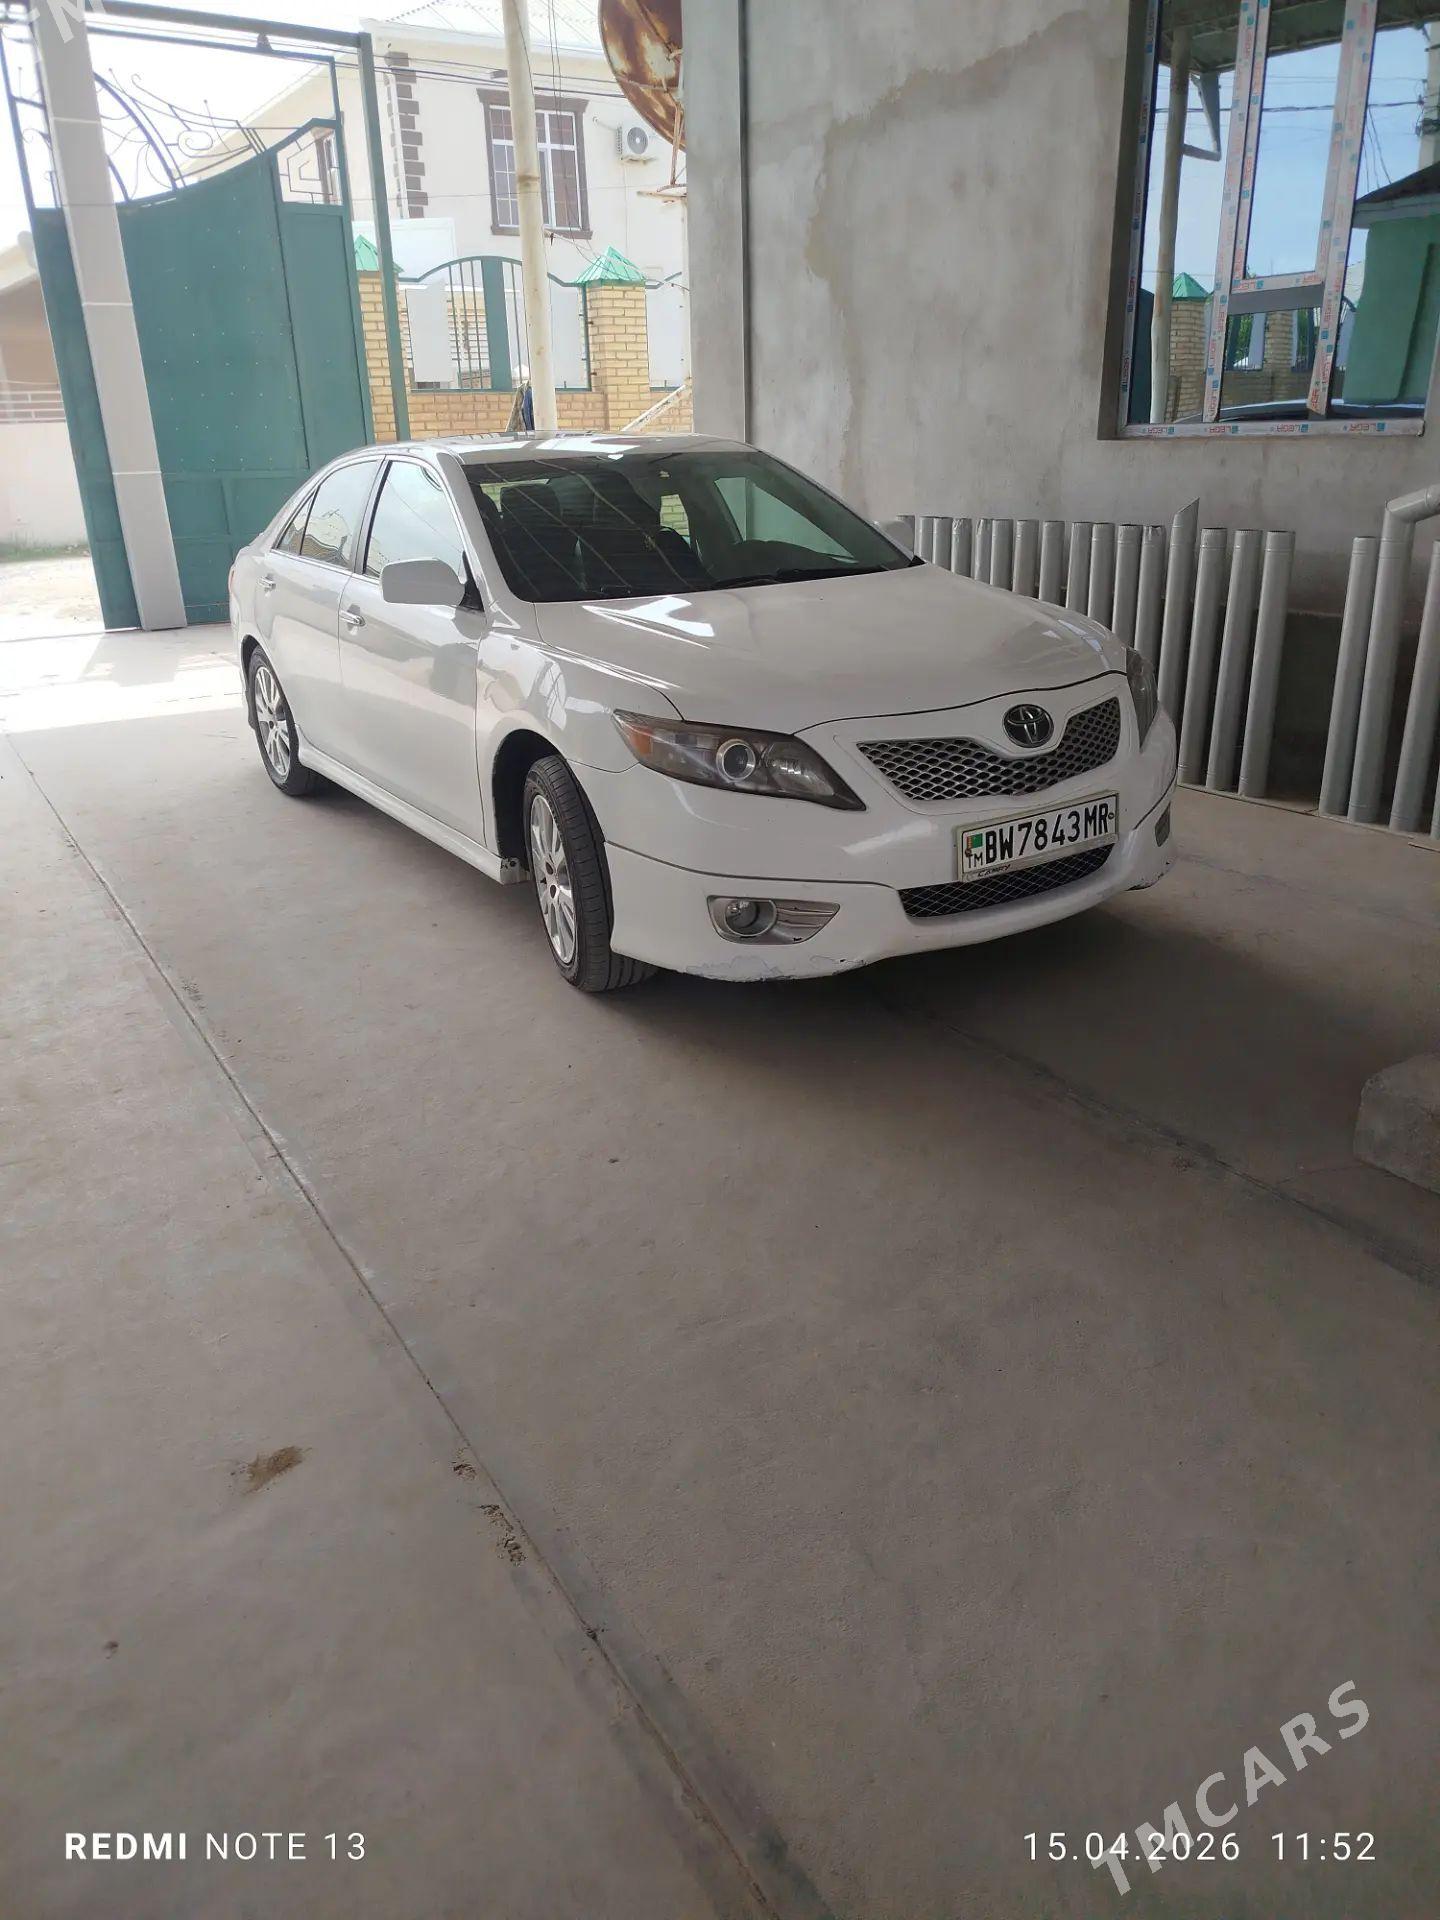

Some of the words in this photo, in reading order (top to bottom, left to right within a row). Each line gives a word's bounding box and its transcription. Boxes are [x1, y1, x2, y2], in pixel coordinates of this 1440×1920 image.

[1209, 425, 1232, 434] LEGA
[1276, 424, 1300, 433] LEGA
[1348, 422, 1377, 432] LEGA
[985, 803, 1109, 864] BW7843MR
